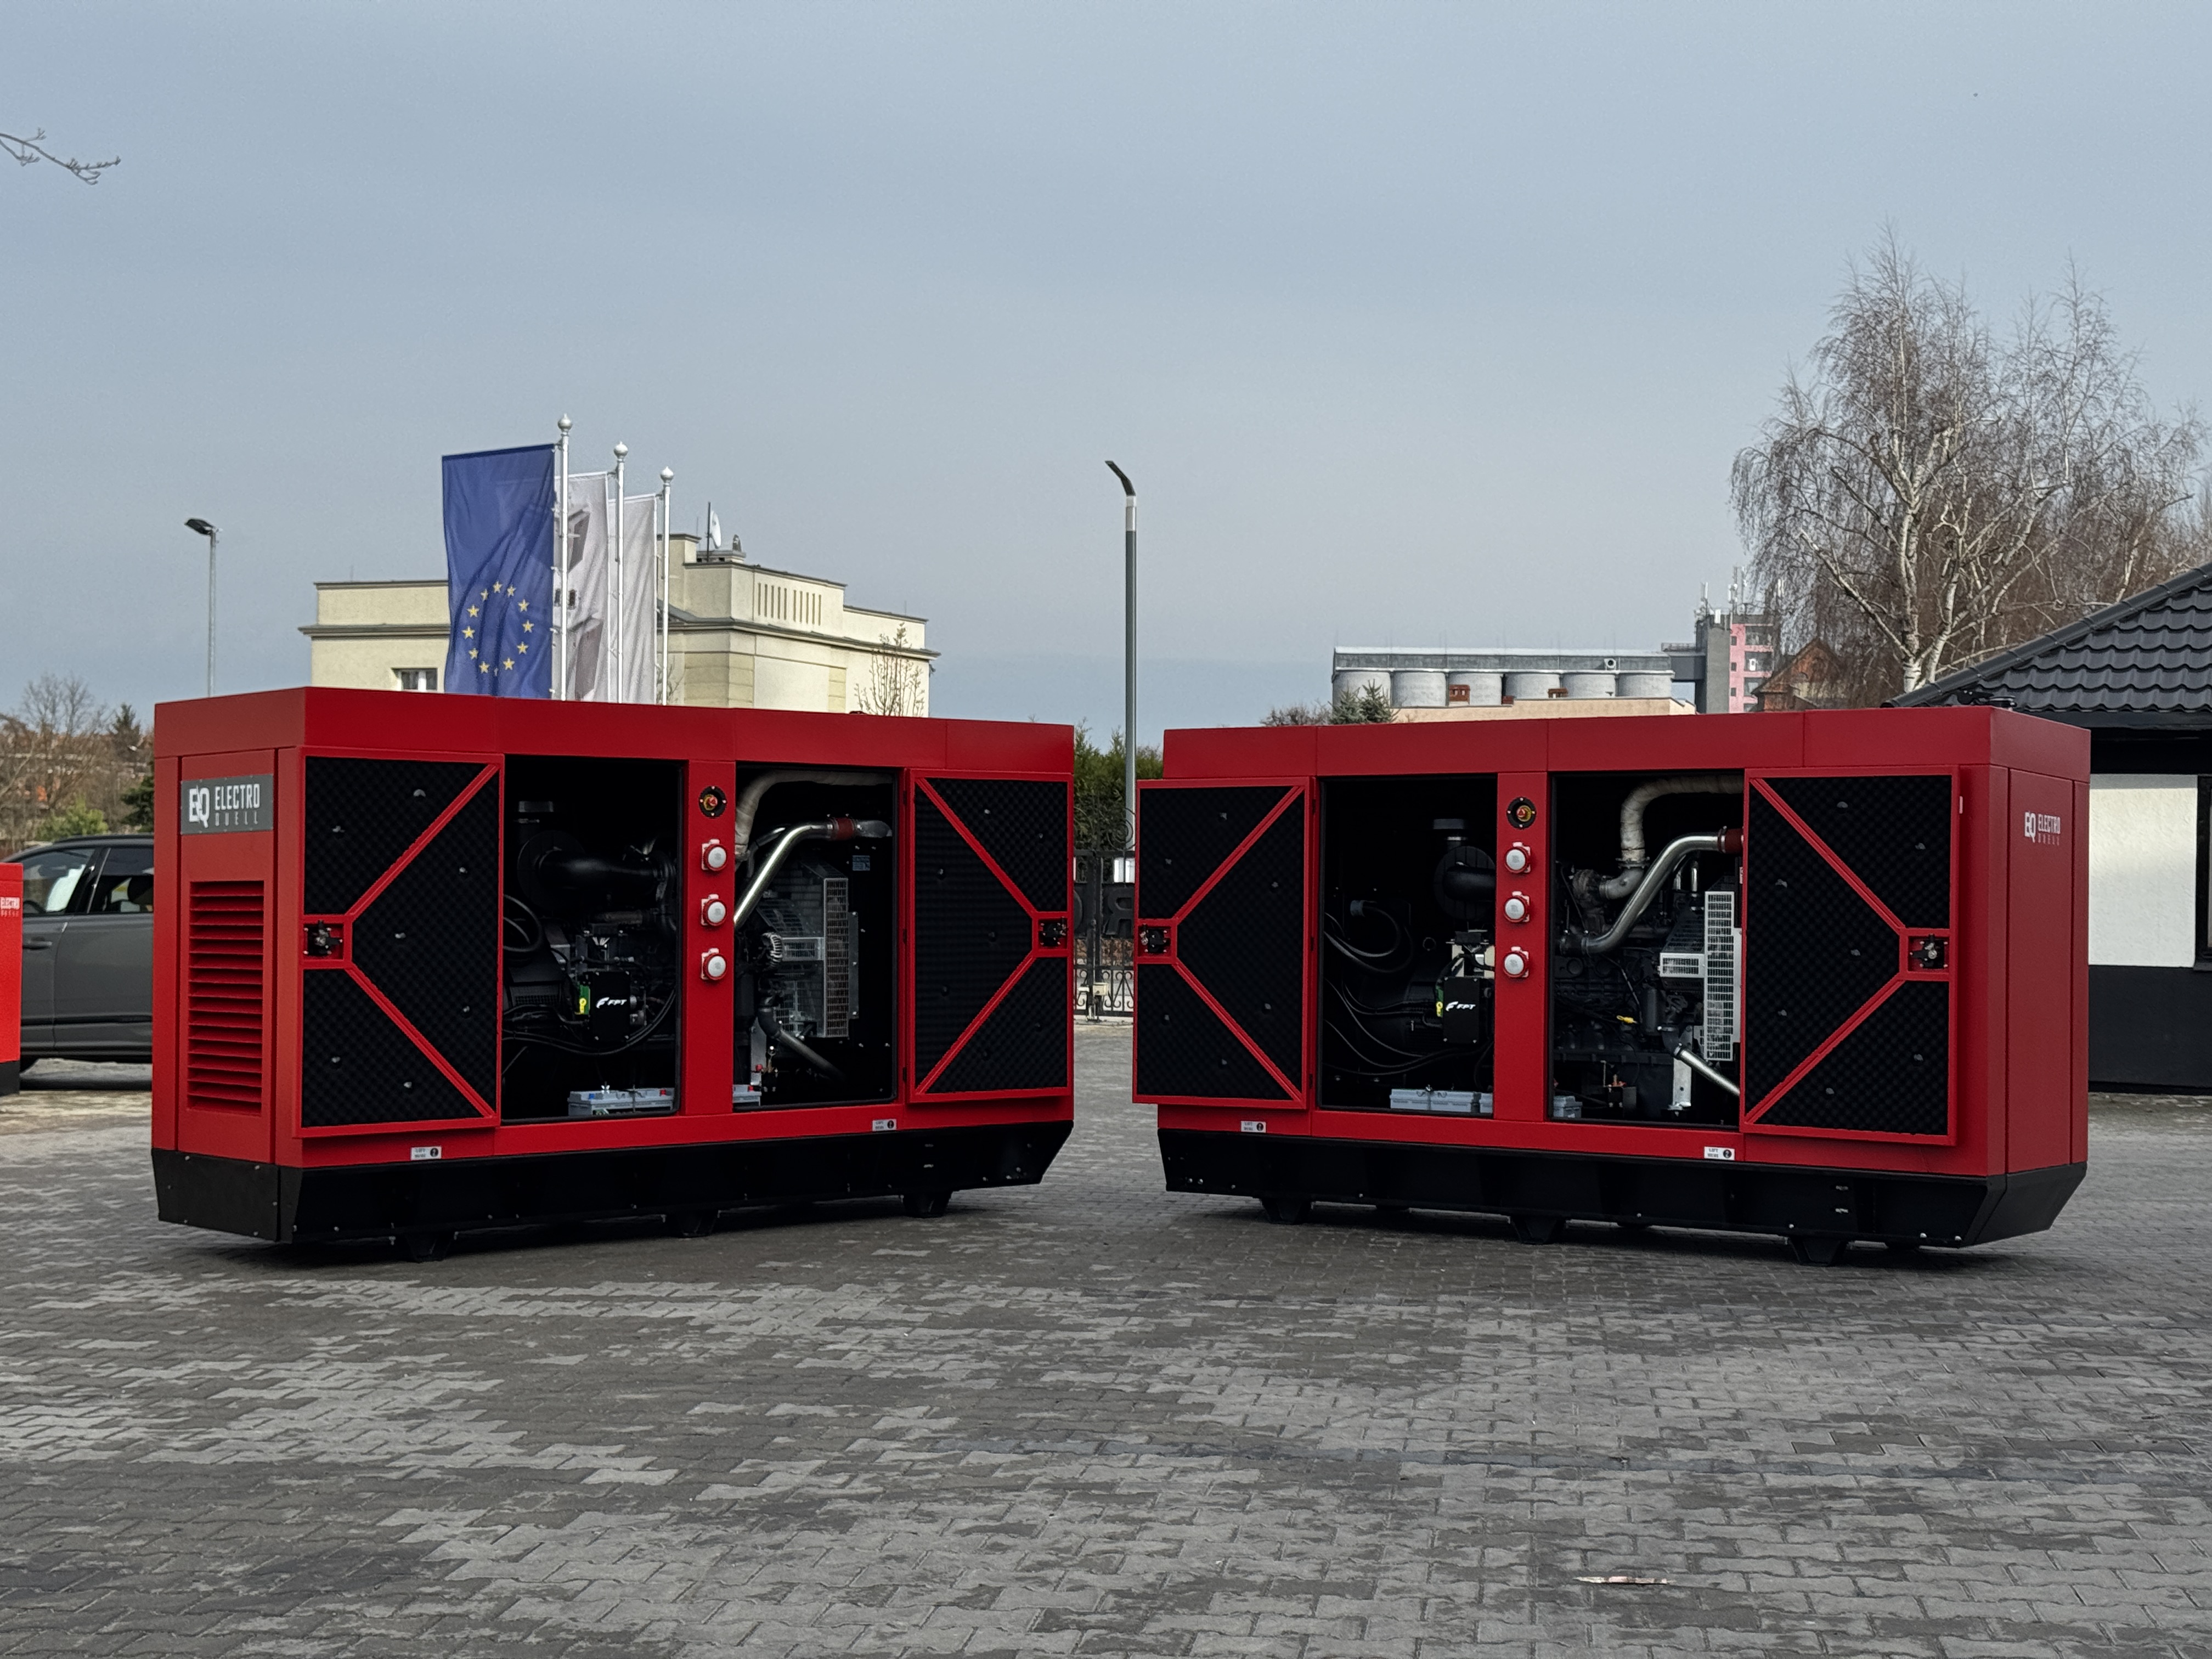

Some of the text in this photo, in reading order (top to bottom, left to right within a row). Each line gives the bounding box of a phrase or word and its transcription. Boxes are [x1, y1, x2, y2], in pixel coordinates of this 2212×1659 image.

[189, 783, 261, 828] EQ ELECTRO
[2024, 811, 2036, 843] EQ
[2038, 814, 2061, 834] ELECTRO
